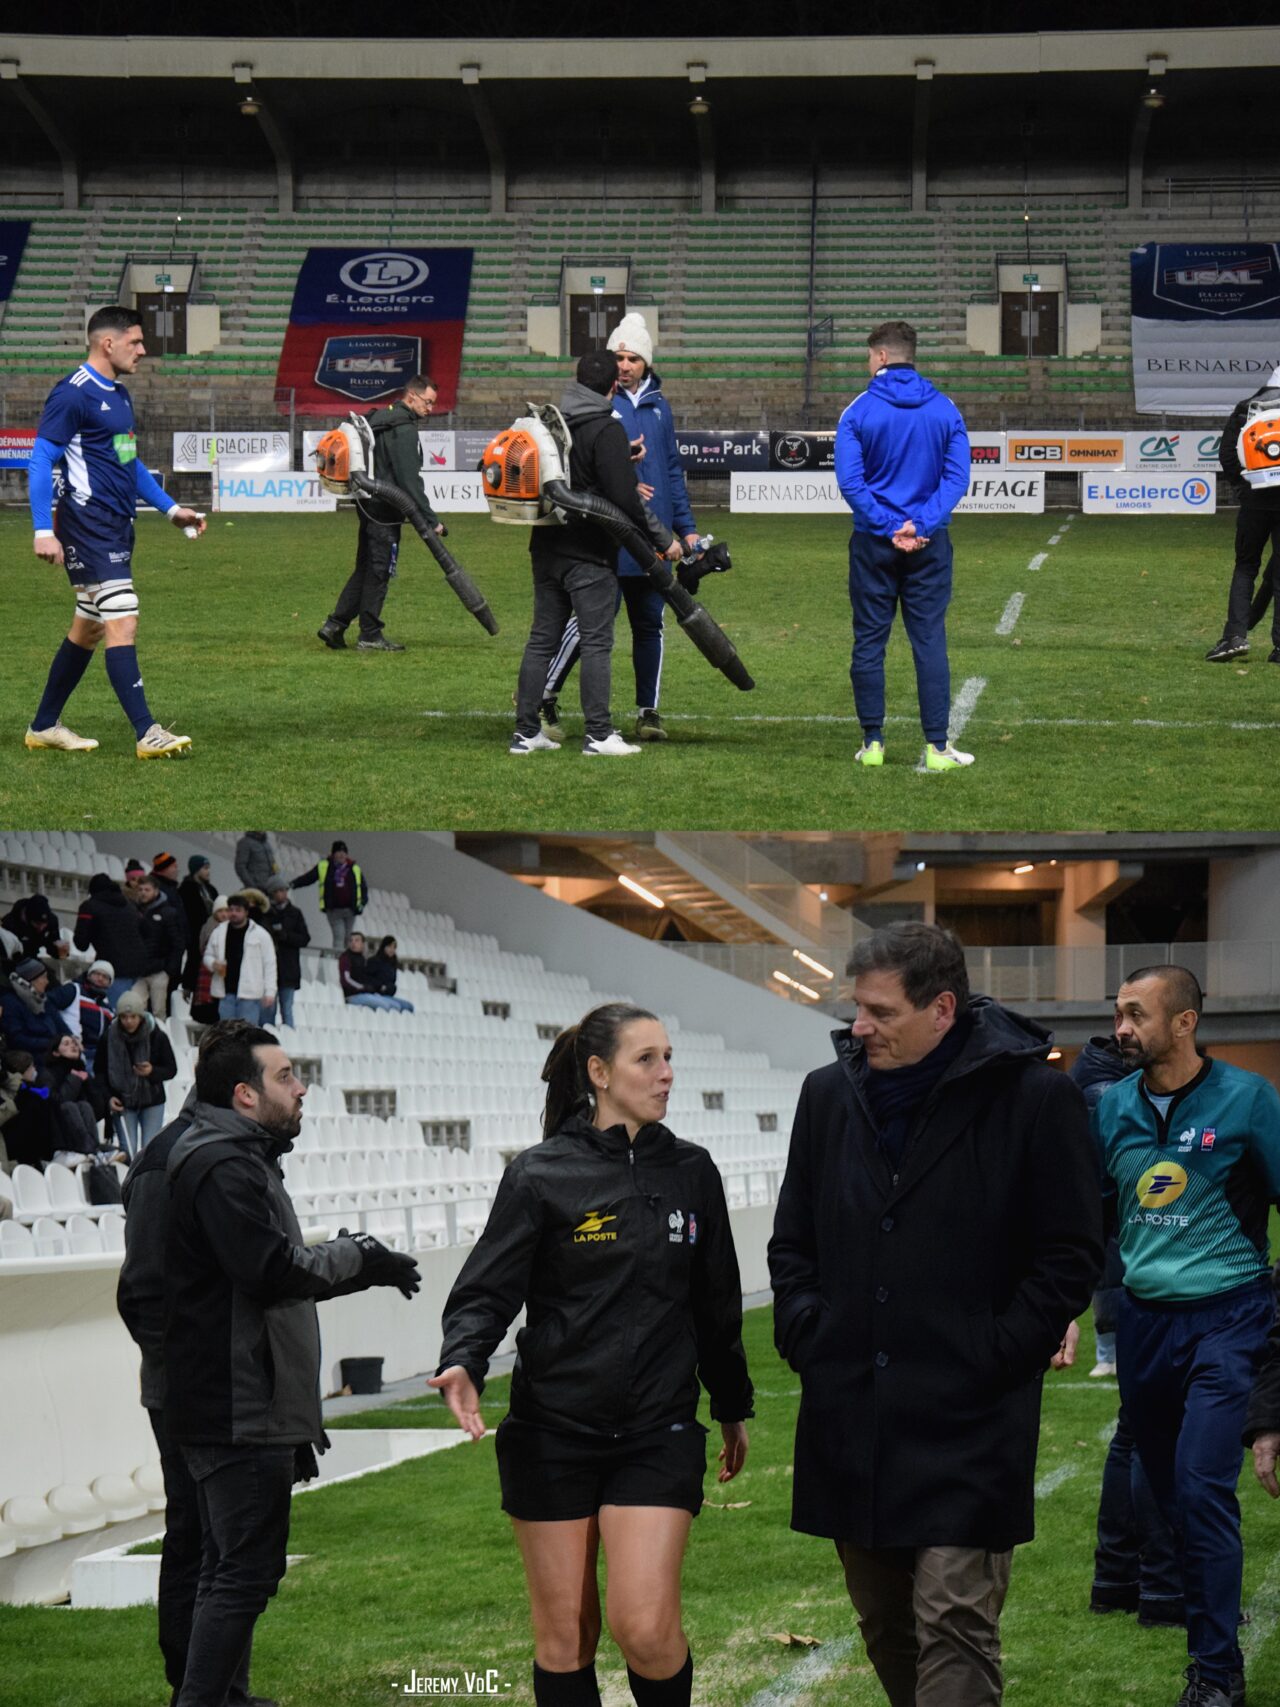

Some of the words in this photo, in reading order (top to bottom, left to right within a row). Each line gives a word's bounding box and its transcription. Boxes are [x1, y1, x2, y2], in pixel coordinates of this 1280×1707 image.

[1176, 270, 1264, 286] USAL
[349, 305, 408, 313] LIMOGES
[336, 357, 403, 373] USAL
[349, 377, 387, 386] RUGBY
[723, 440, 762, 455] Park
[1015, 445, 1063, 460] JCB
[1069, 449, 1119, 458] OMNIMAT
[432, 484, 481, 500] WEST
[1087, 484, 1180, 500] E.Leclerc
[1115, 501, 1152, 509] LIMOGES
[1146, 1213, 1190, 1227] POSTE
[573, 1233, 587, 1243] LA
[587, 1231, 617, 1242] POSTE
